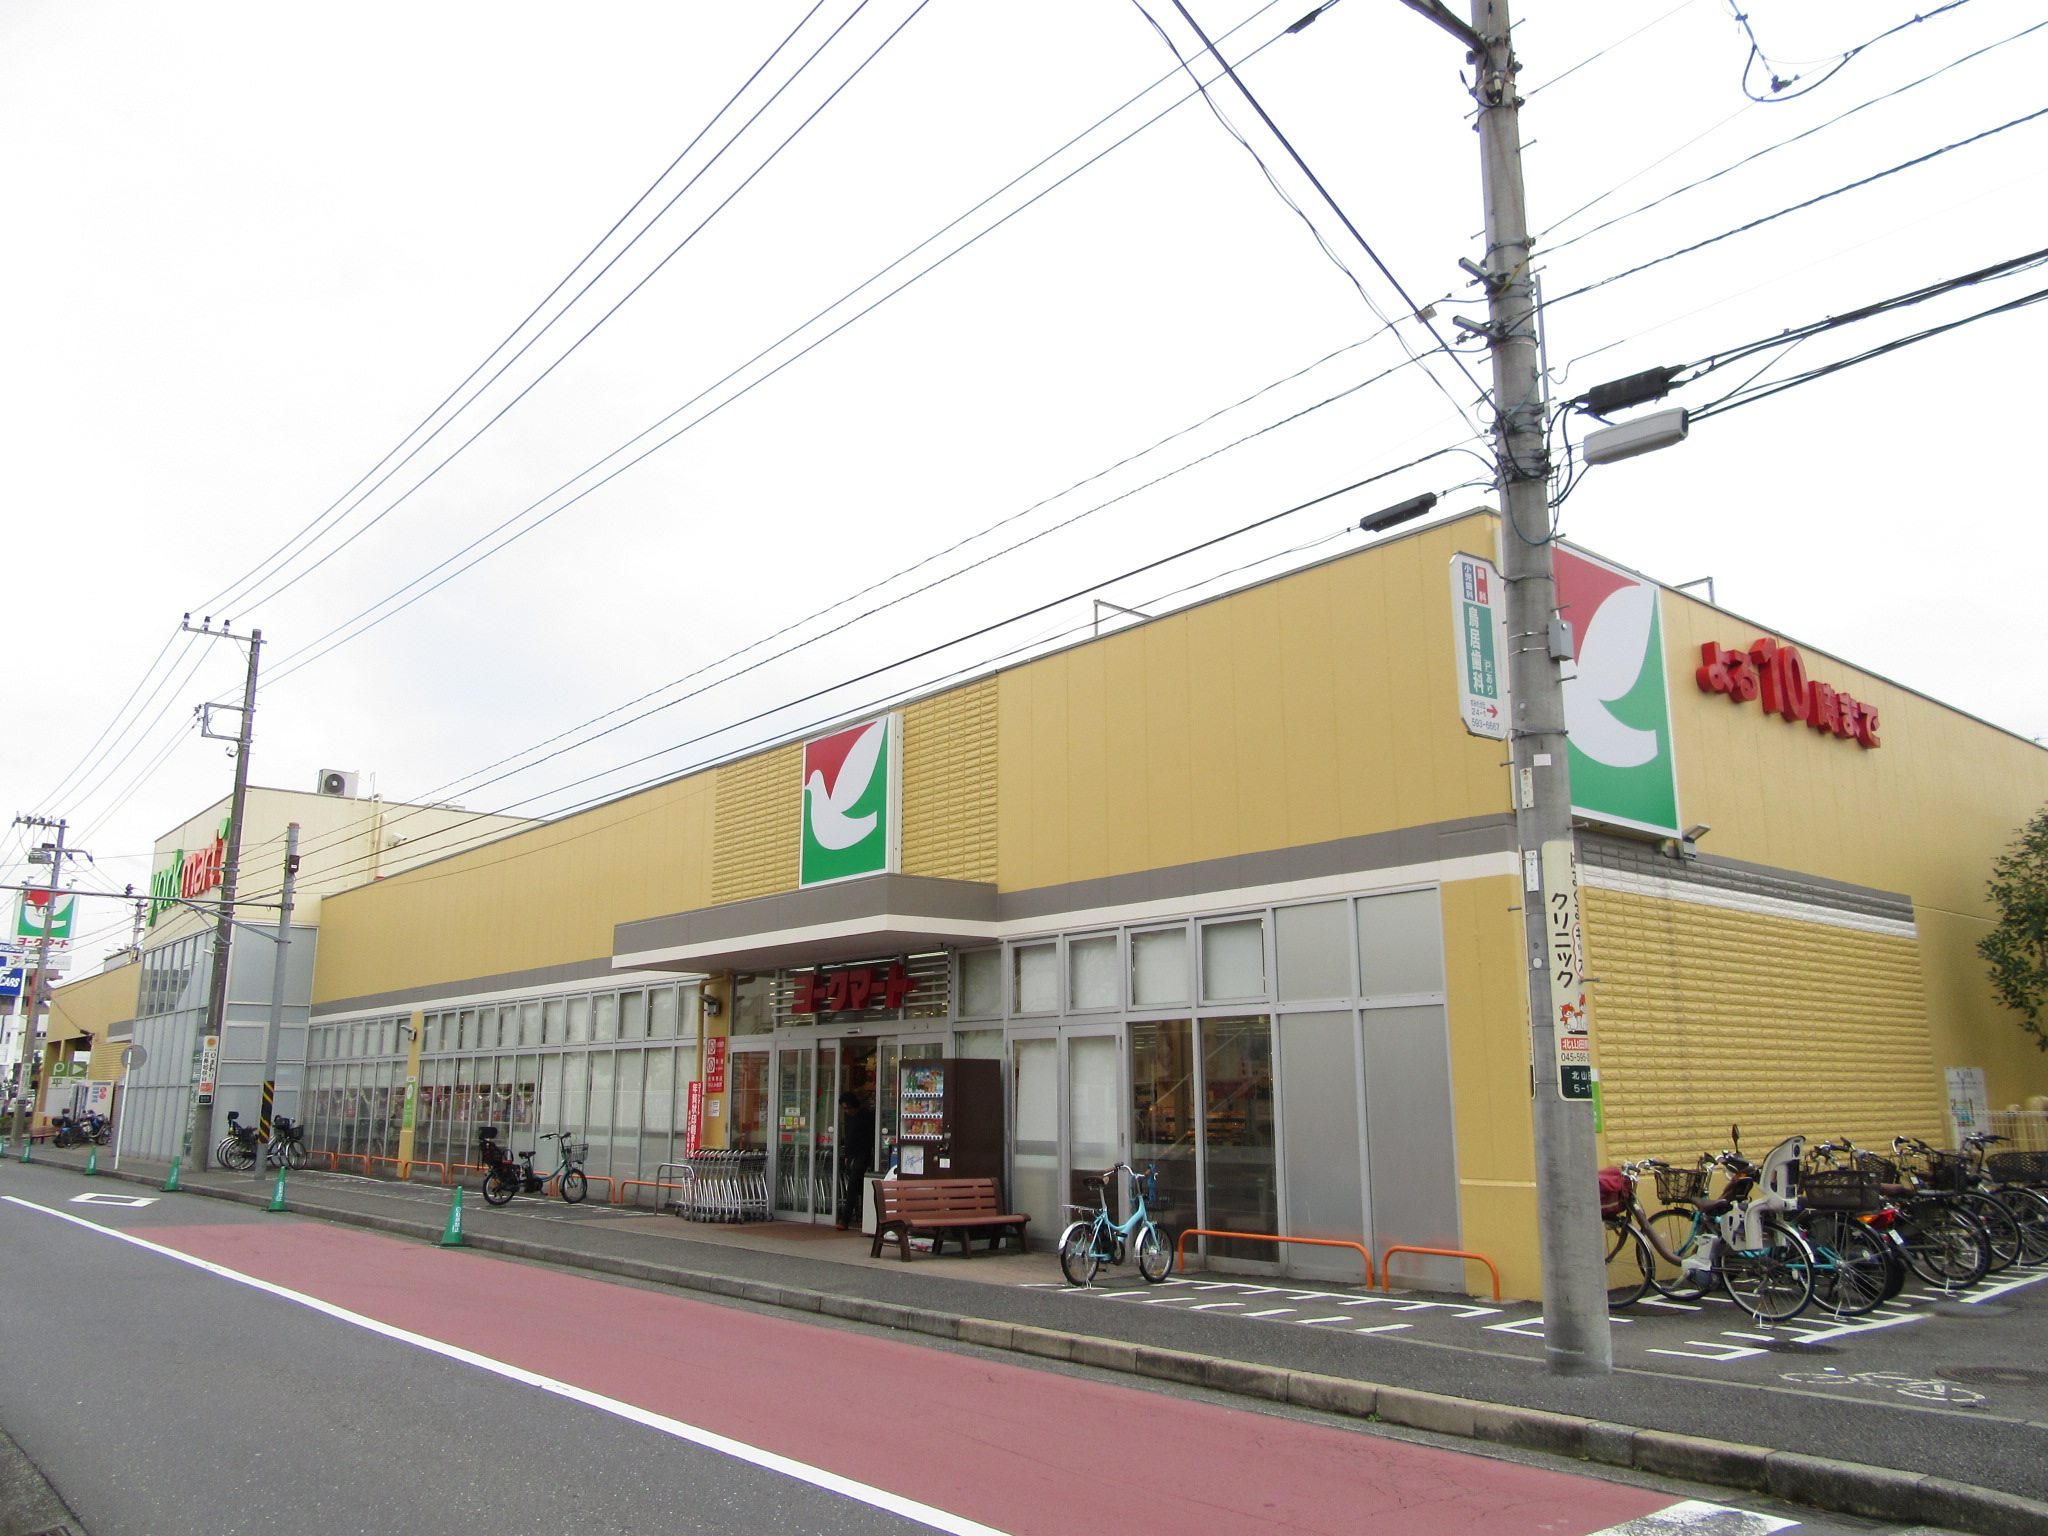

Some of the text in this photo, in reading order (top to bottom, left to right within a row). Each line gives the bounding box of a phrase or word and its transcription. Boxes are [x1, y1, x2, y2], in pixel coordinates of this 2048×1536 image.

[1469, 606, 1485, 694] 鳥居歯科
[1551, 892, 1574, 989] クリニック
[790, 963, 915, 1014] ヨークマート
